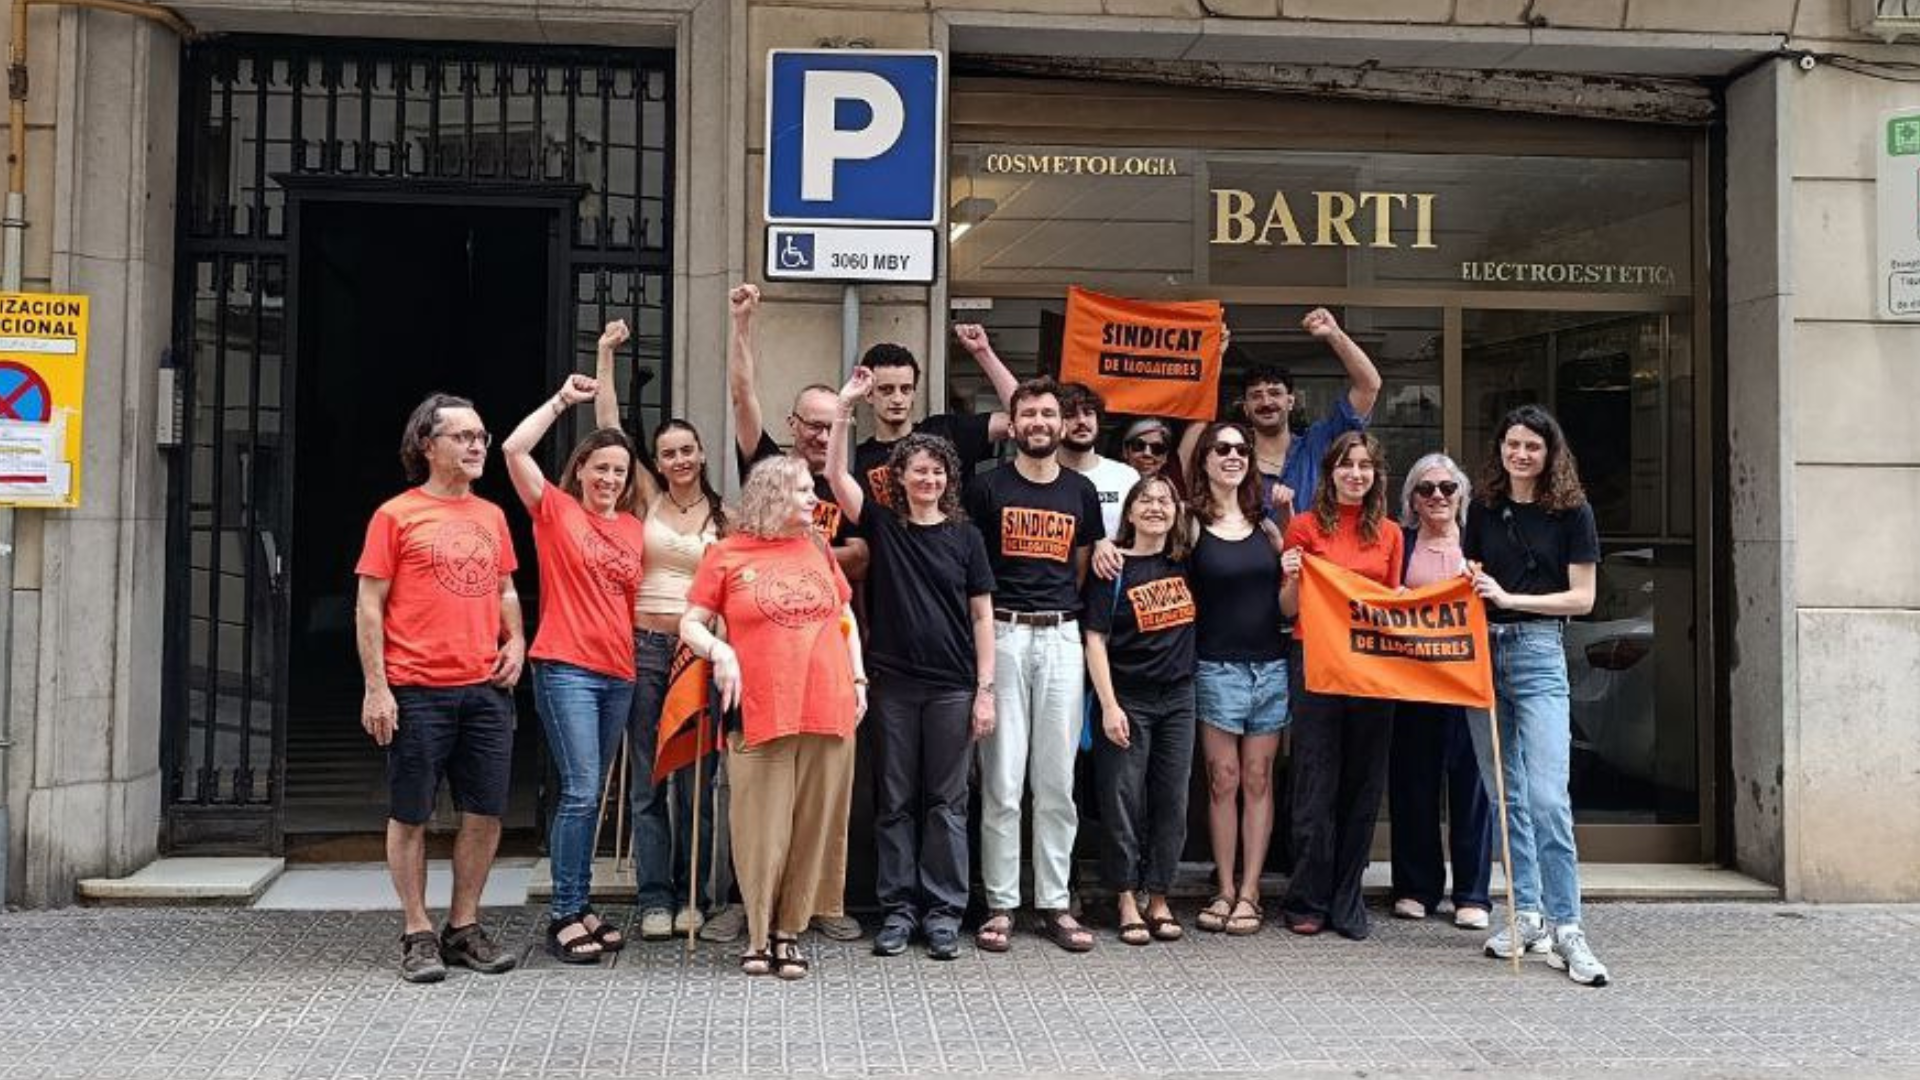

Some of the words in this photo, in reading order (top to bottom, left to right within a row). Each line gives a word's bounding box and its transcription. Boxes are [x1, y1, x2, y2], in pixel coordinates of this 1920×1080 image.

[801, 70, 905, 201] P
[987, 154, 1177, 176] COSMETOLOGIA
[1210, 188, 1438, 249] BARTI
[831, 253, 868, 270] 3060
[873, 254, 910, 270] MBY
[1462, 262, 1676, 286] ELECTROESTETICA
[2, 318, 78, 336] CIONAL
[1102, 321, 1202, 352] SINDICAT
[1104, 358, 1119, 371] DE
[1006, 511, 1074, 541] SINDICAT
[1348, 600, 1468, 629] SINDICAT
[1356, 635, 1375, 650] DE
